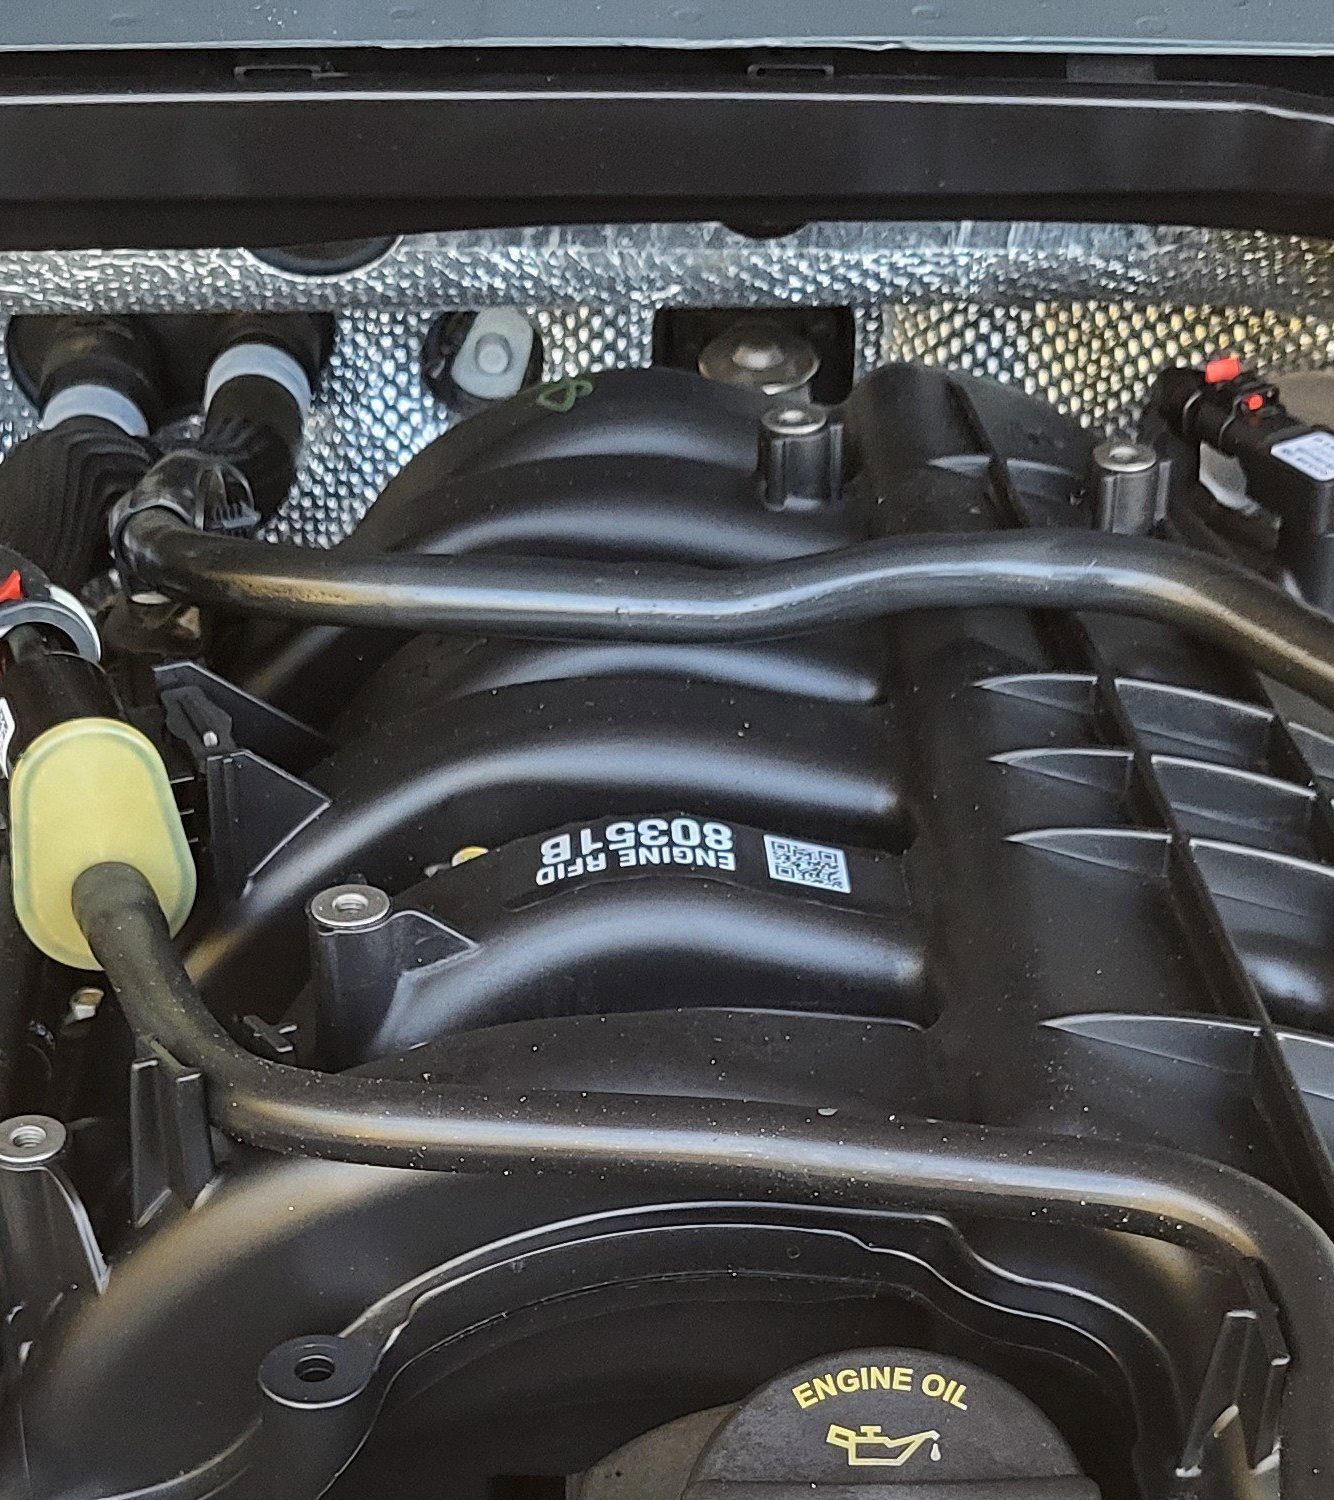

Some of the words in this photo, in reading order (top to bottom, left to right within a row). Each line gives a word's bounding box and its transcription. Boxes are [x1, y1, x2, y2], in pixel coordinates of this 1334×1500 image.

[540, 818, 733, 866] 80351B
[619, 847, 736, 871] ENGINE
[535, 852, 607, 886] RFID
[791, 1366, 914, 1409] ENGINE
[921, 1373, 968, 1411] OIL
